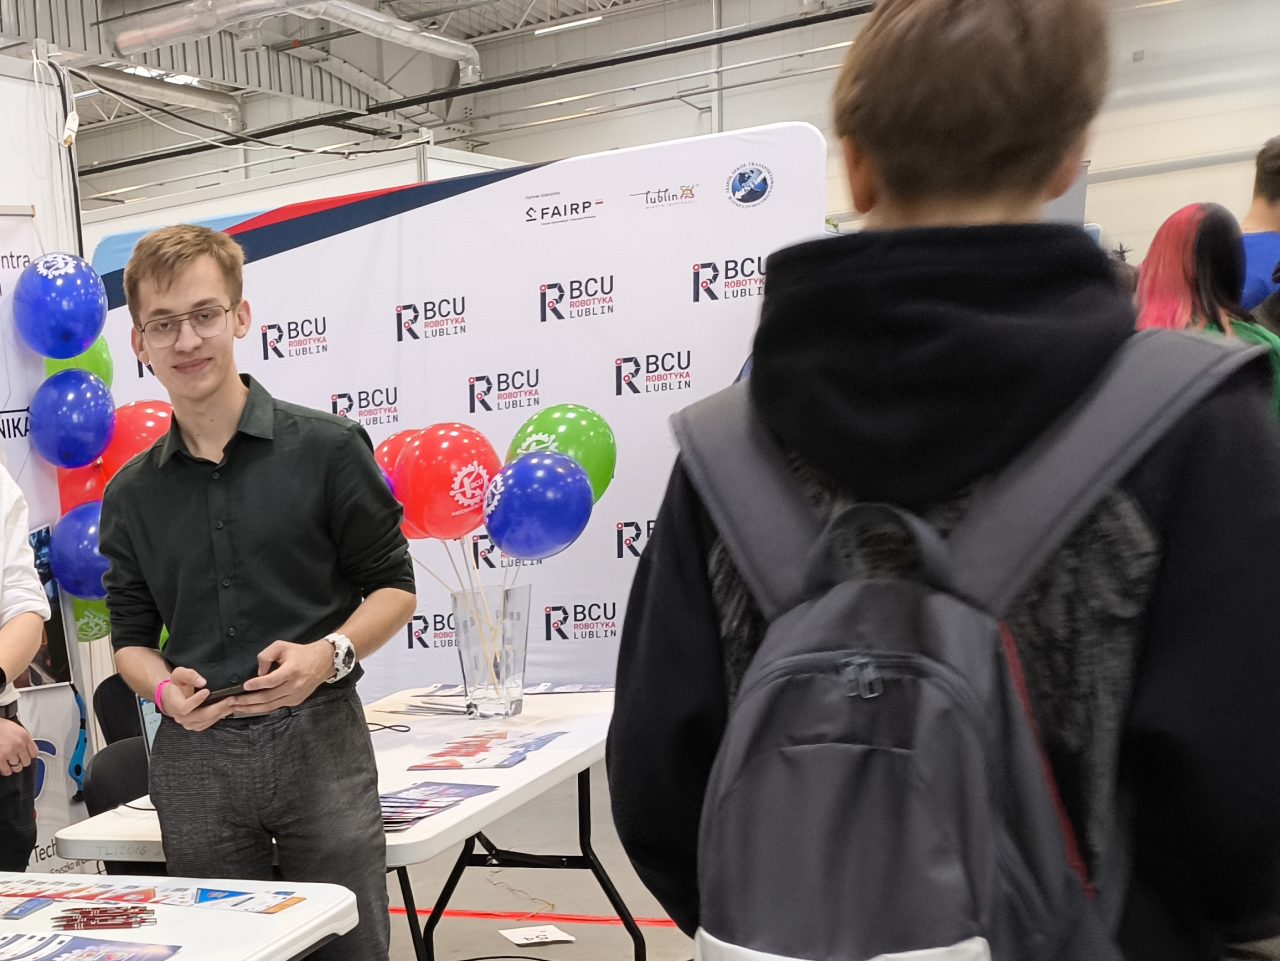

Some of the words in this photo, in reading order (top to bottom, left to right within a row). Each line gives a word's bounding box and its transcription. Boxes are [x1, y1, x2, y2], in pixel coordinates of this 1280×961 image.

[540, 201, 592, 220] FAIRP
[724, 256, 767, 280] BCU
[569, 275, 614, 300] BCU
[724, 278, 766, 289] ROBOTYK
[724, 287, 765, 300] LUBLI
[424, 296, 466, 320] BCU
[569, 296, 614, 309] ROBOTYKA
[569, 305, 614, 319] LUBLIN
[287, 317, 327, 339] BCU
[424, 316, 466, 329] ROBOTYKA
[424, 325, 466, 339] LUBLIN
[288, 336, 327, 348] ROBOTYKA
[288, 344, 328, 357] LUBLIN
[645, 350, 691, 374] BCU
[496, 368, 540, 392] BCU
[645, 371, 691, 383] ROBOTYKA
[645, 379, 691, 393] LUBLIN
[358, 387, 398, 409] BCU
[497, 388, 540, 401] ROBOTYKA
[497, 397, 540, 411] LUBLIN
[358, 406, 398, 417] ROBOTYKA
[358, 414, 399, 427] LUBLIN
[573, 602, 616, 622] BCU
[433, 612, 455, 631] BC
[573, 621, 616, 630] ROBOTYKA
[573, 629, 617, 640] LUBLIN
